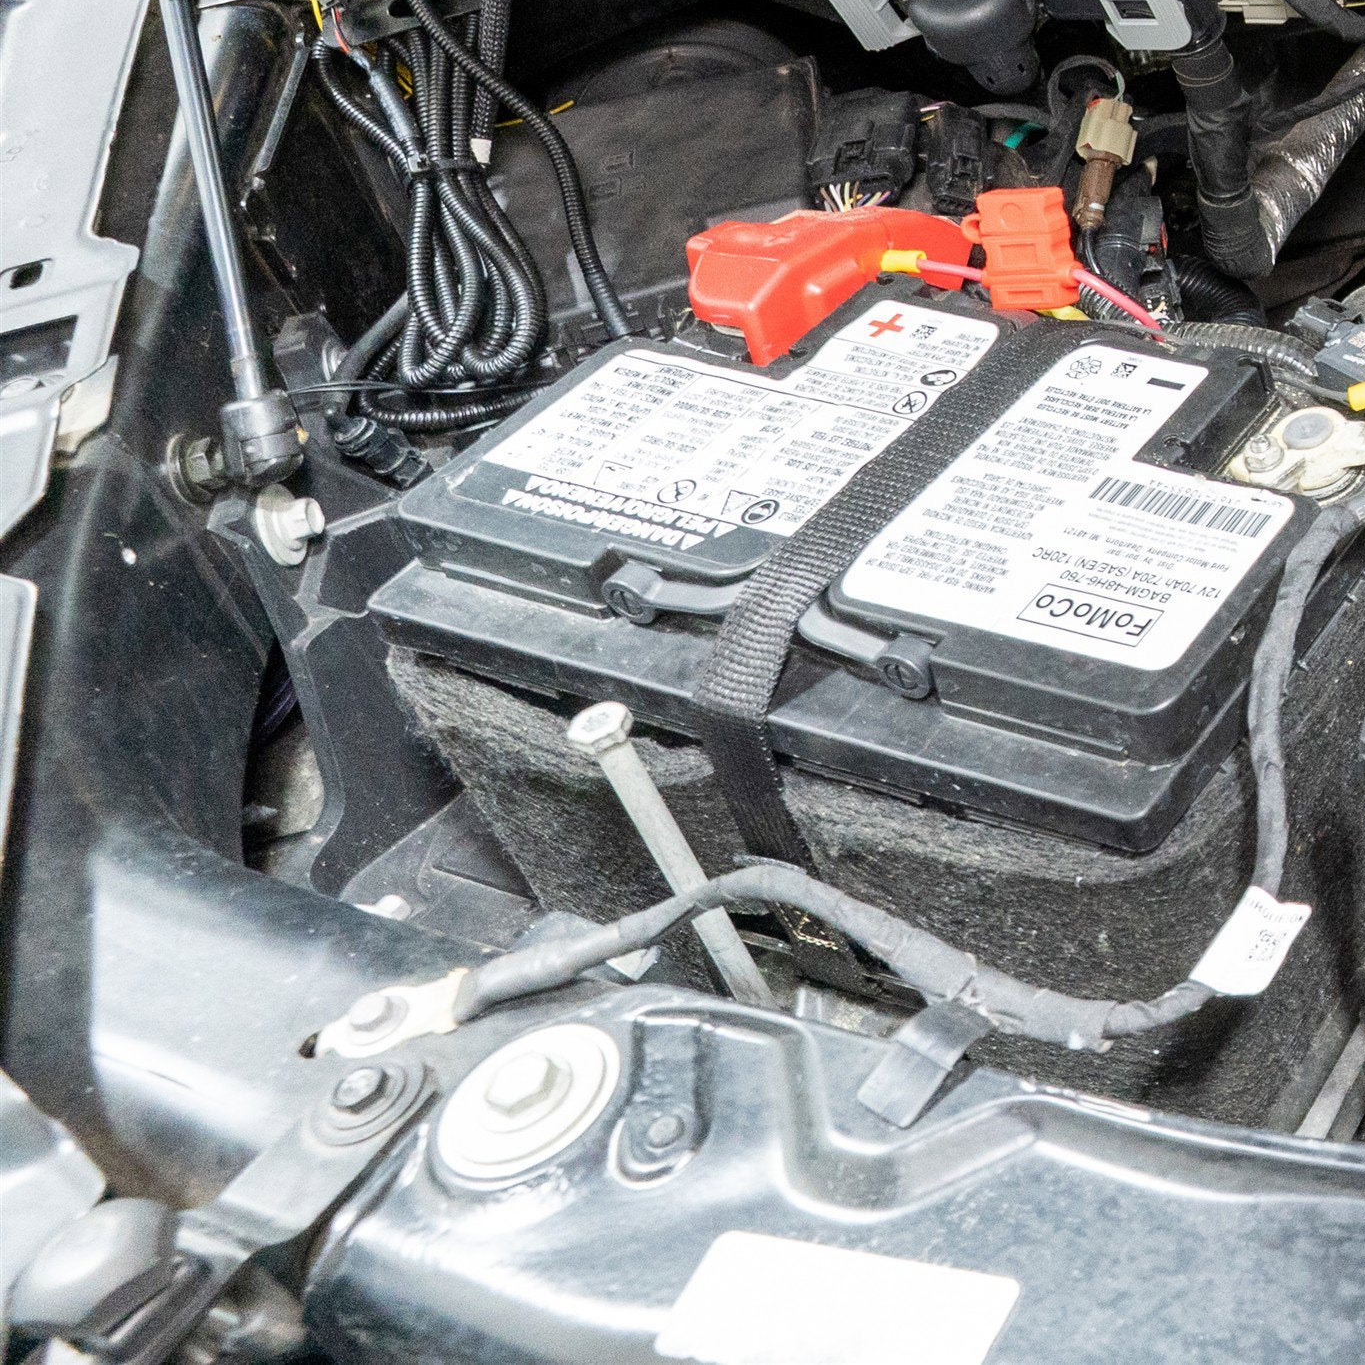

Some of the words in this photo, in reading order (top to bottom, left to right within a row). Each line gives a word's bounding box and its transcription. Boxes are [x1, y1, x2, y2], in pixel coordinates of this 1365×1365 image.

[1032, 547, 1071, 563] 120RC
[1074, 559, 1131, 577] (SAE/EN)
[1132, 571, 1162, 585] 720A
[1165, 579, 1196, 593] 70Ah
[1060, 570, 1171, 603] BAGM-48H6-760
[1197, 586, 1221, 598] 12V
[1036, 595, 1151, 636] FoMoCo
